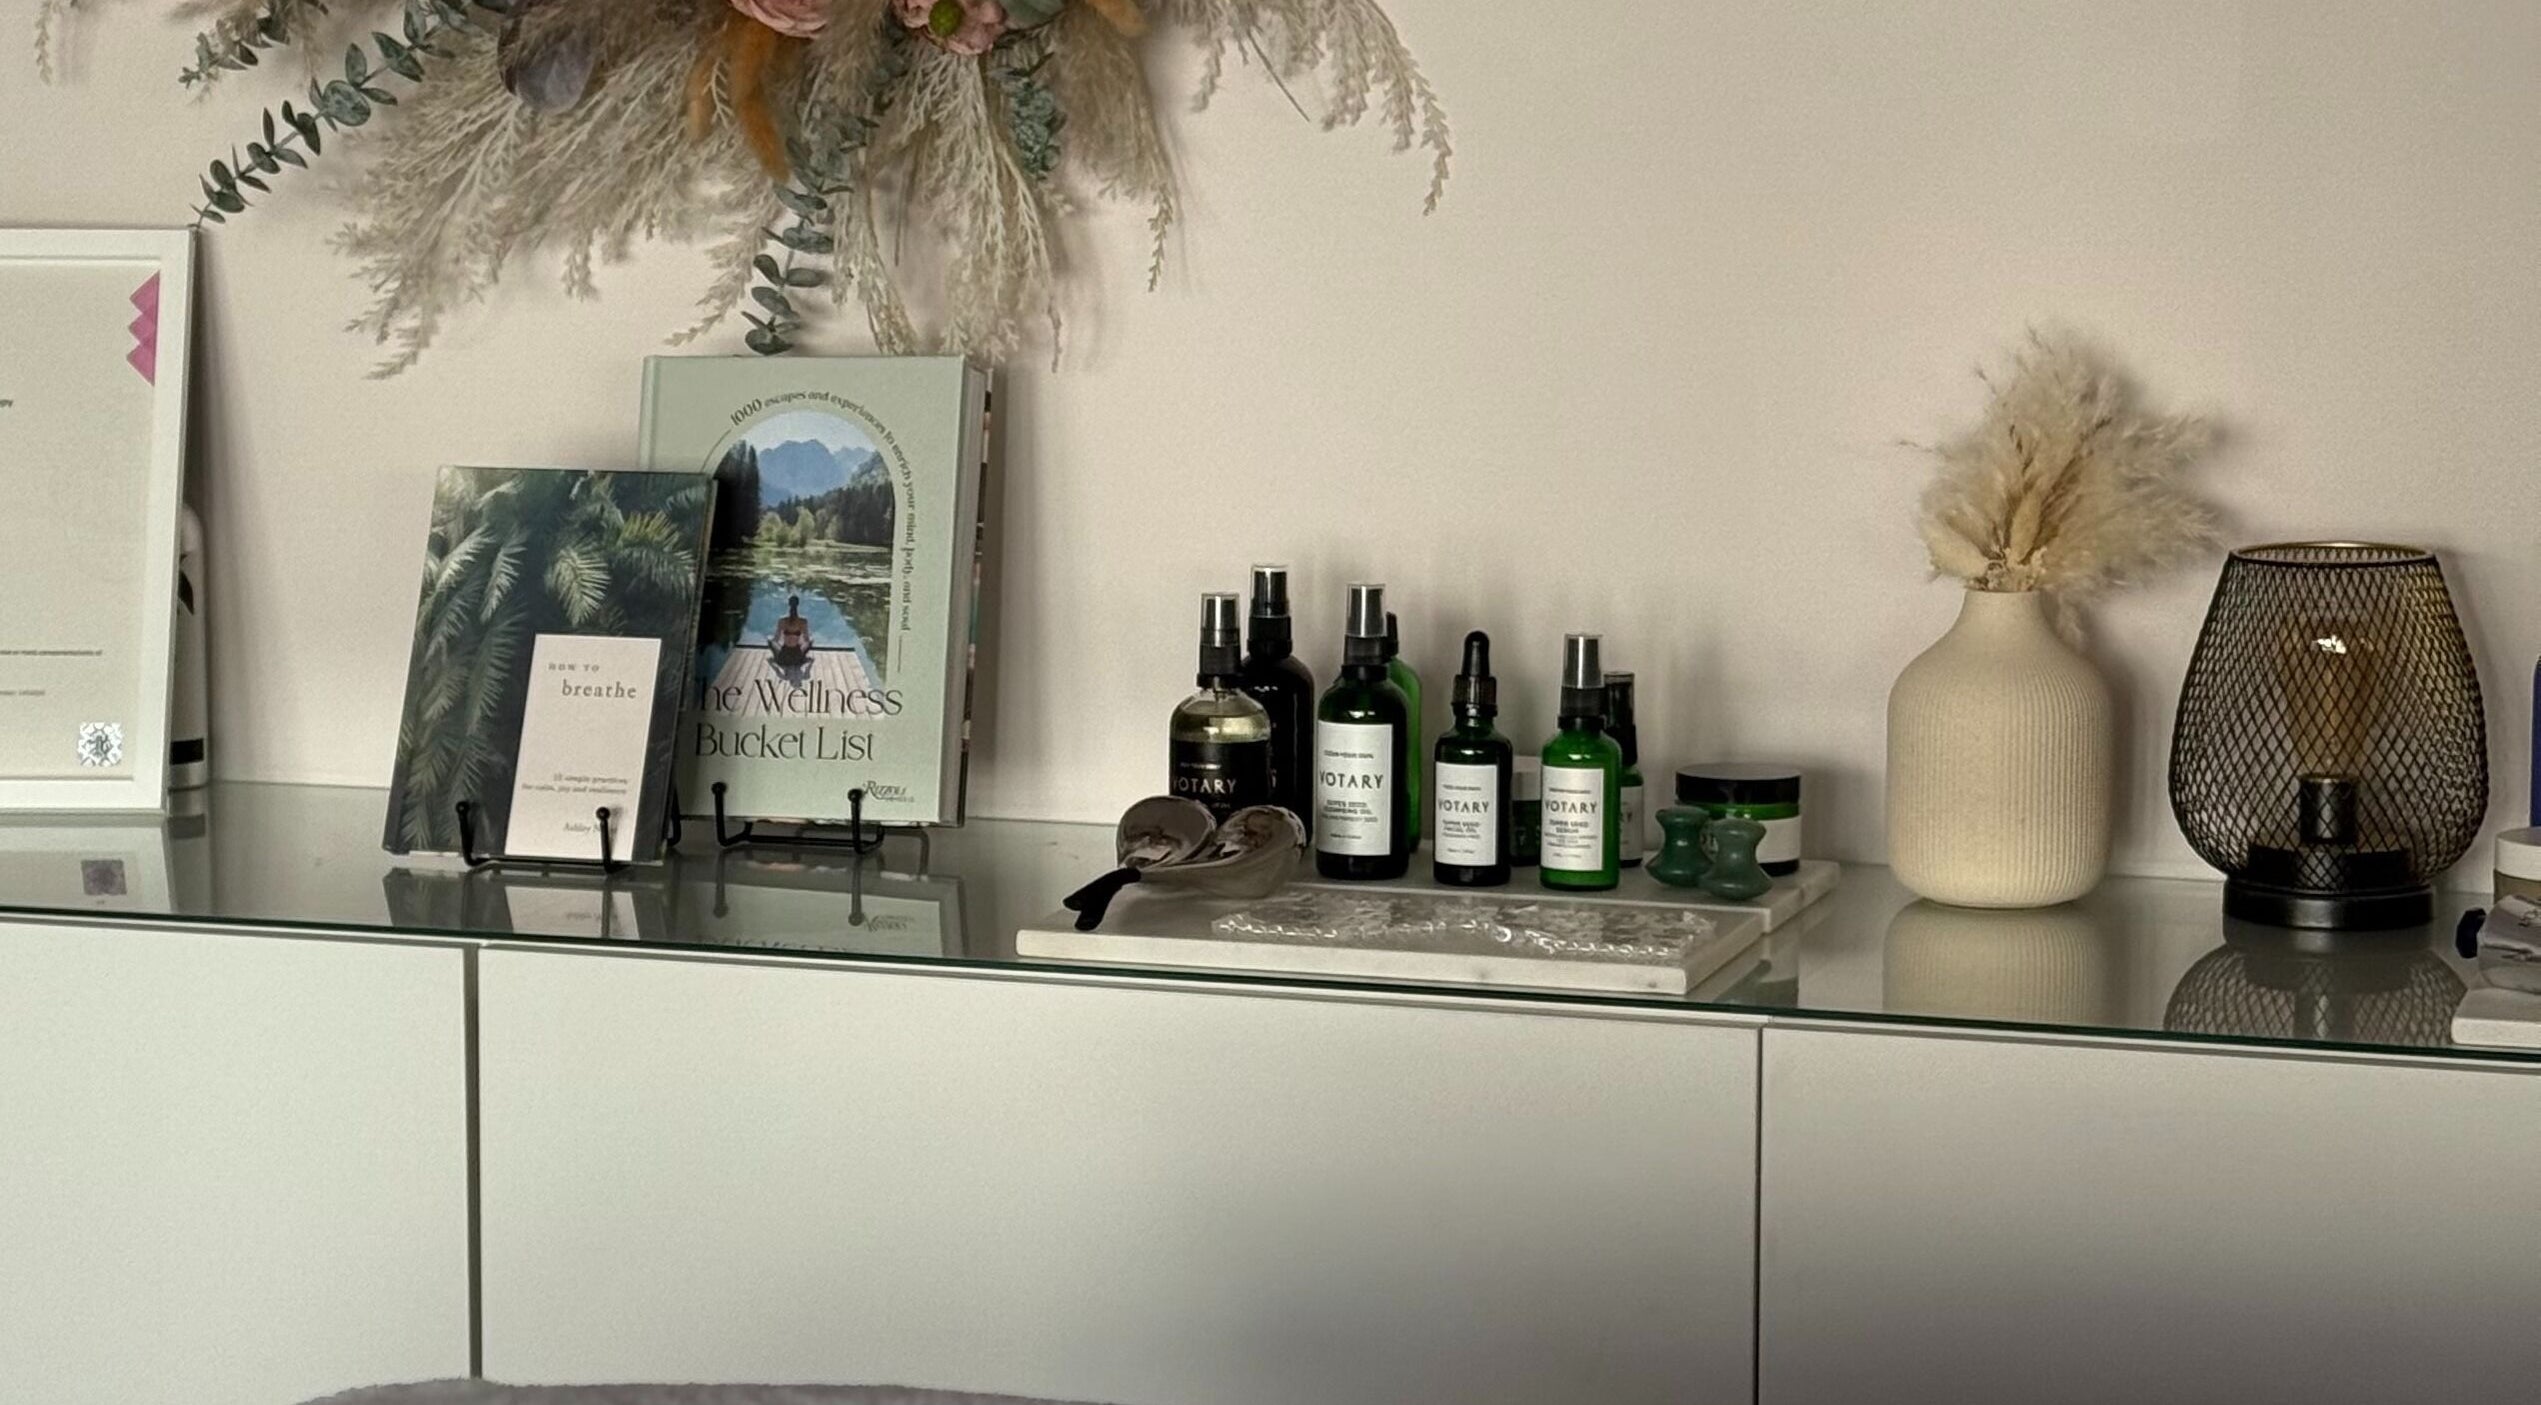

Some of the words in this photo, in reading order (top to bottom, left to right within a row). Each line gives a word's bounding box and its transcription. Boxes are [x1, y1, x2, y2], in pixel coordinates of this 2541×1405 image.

[808, 391, 830, 401] and
[730, 398, 762, 426] 1000
[892, 442, 912, 480] enrich
[903, 479, 916, 511] your
[902, 580, 912, 604] and
[901, 605, 911, 631] soul
[583, 663, 600, 673] TO
[561, 677, 637, 699] breathe
[754, 677, 904, 716] Wellness
[695, 721, 805, 761] Bucket
[816, 726, 873, 761] List
[1319, 770, 1384, 790] VOTARY
[1438, 798, 1489, 813] VOTARY
[1544, 799, 1598, 814] VOTARY
